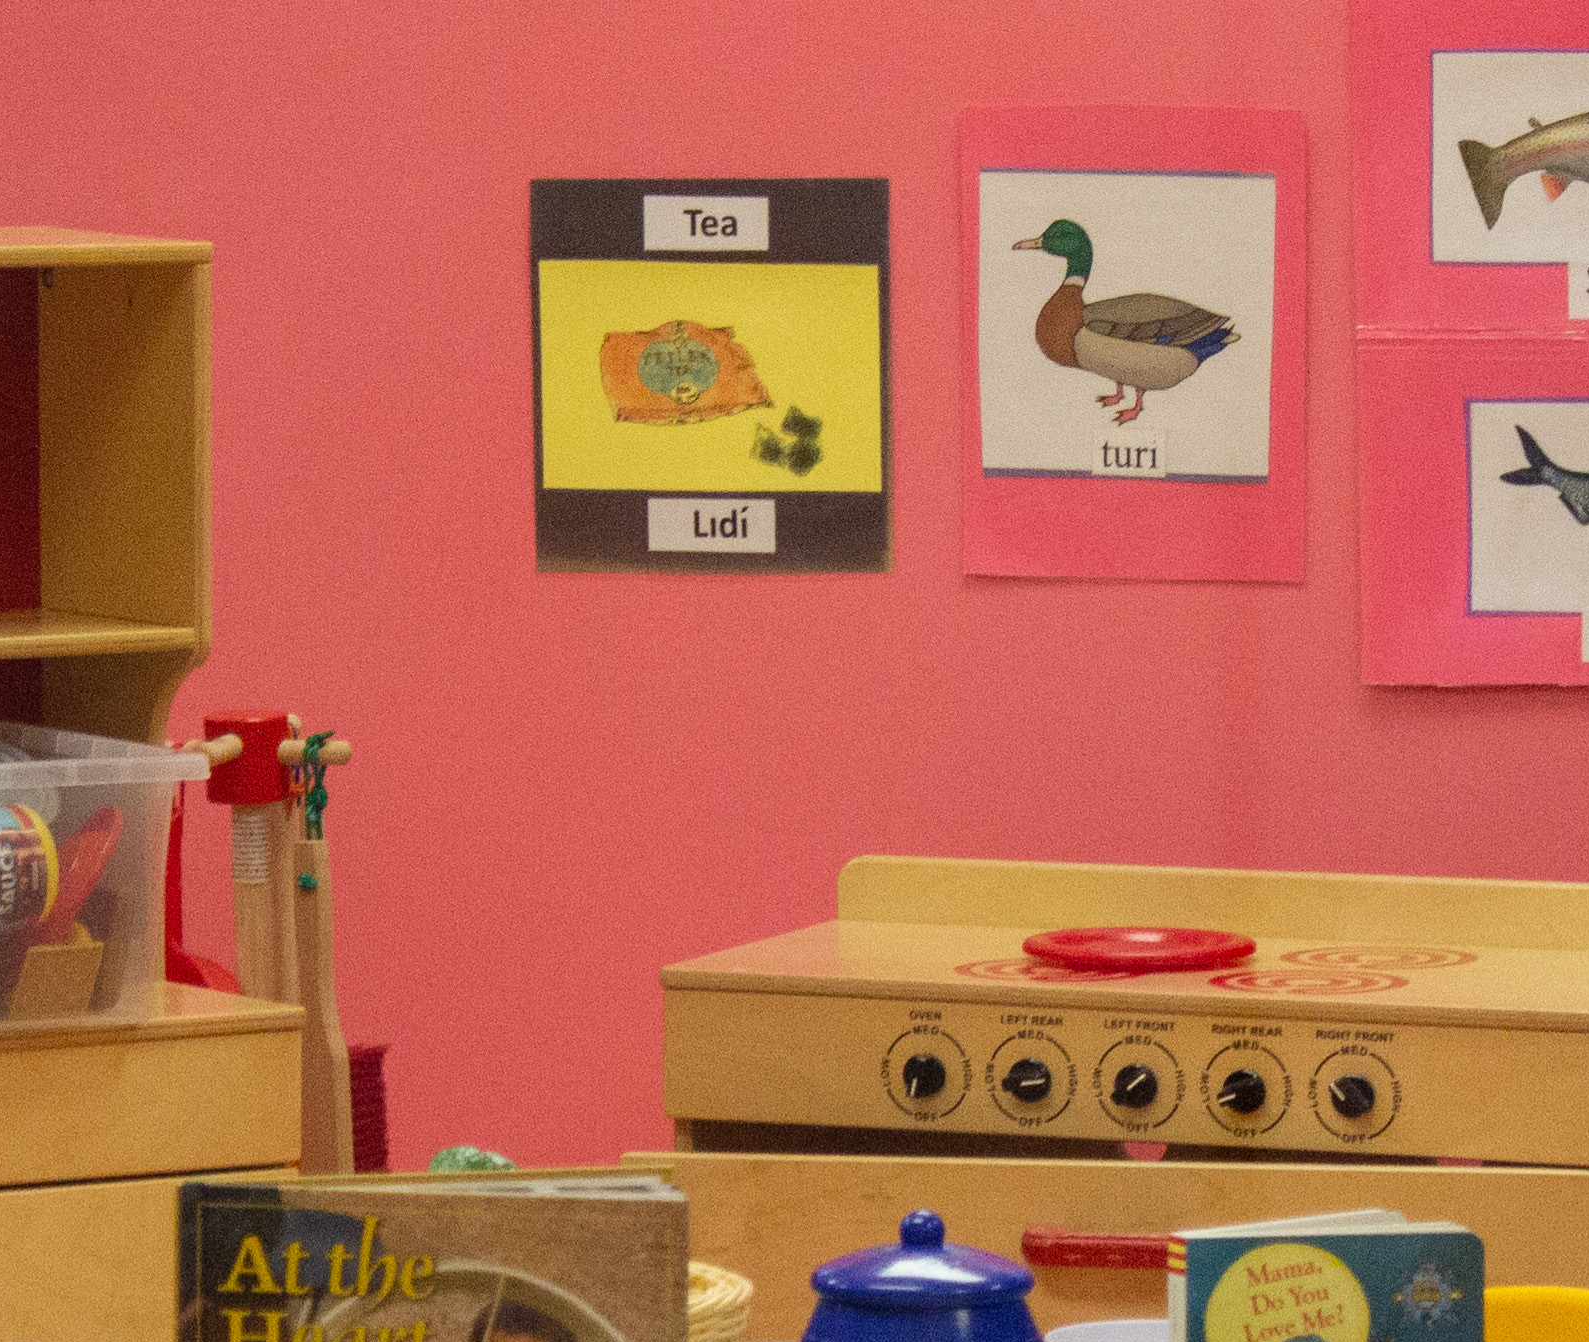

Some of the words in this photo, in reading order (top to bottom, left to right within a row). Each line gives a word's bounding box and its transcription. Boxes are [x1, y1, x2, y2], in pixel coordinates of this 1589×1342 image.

[683, 208, 738, 237] Tea
[910, 1010, 942, 1021] OVEN
[1000, 1014, 1028, 1025] LEFT
[1103, 1019, 1133, 1030] LEFT
[217, 1234, 310, 1295] At
[326, 1216, 435, 1313] the
[1251, 1293, 1285, 1316] Do
[1288, 1284, 1330, 1307] You
